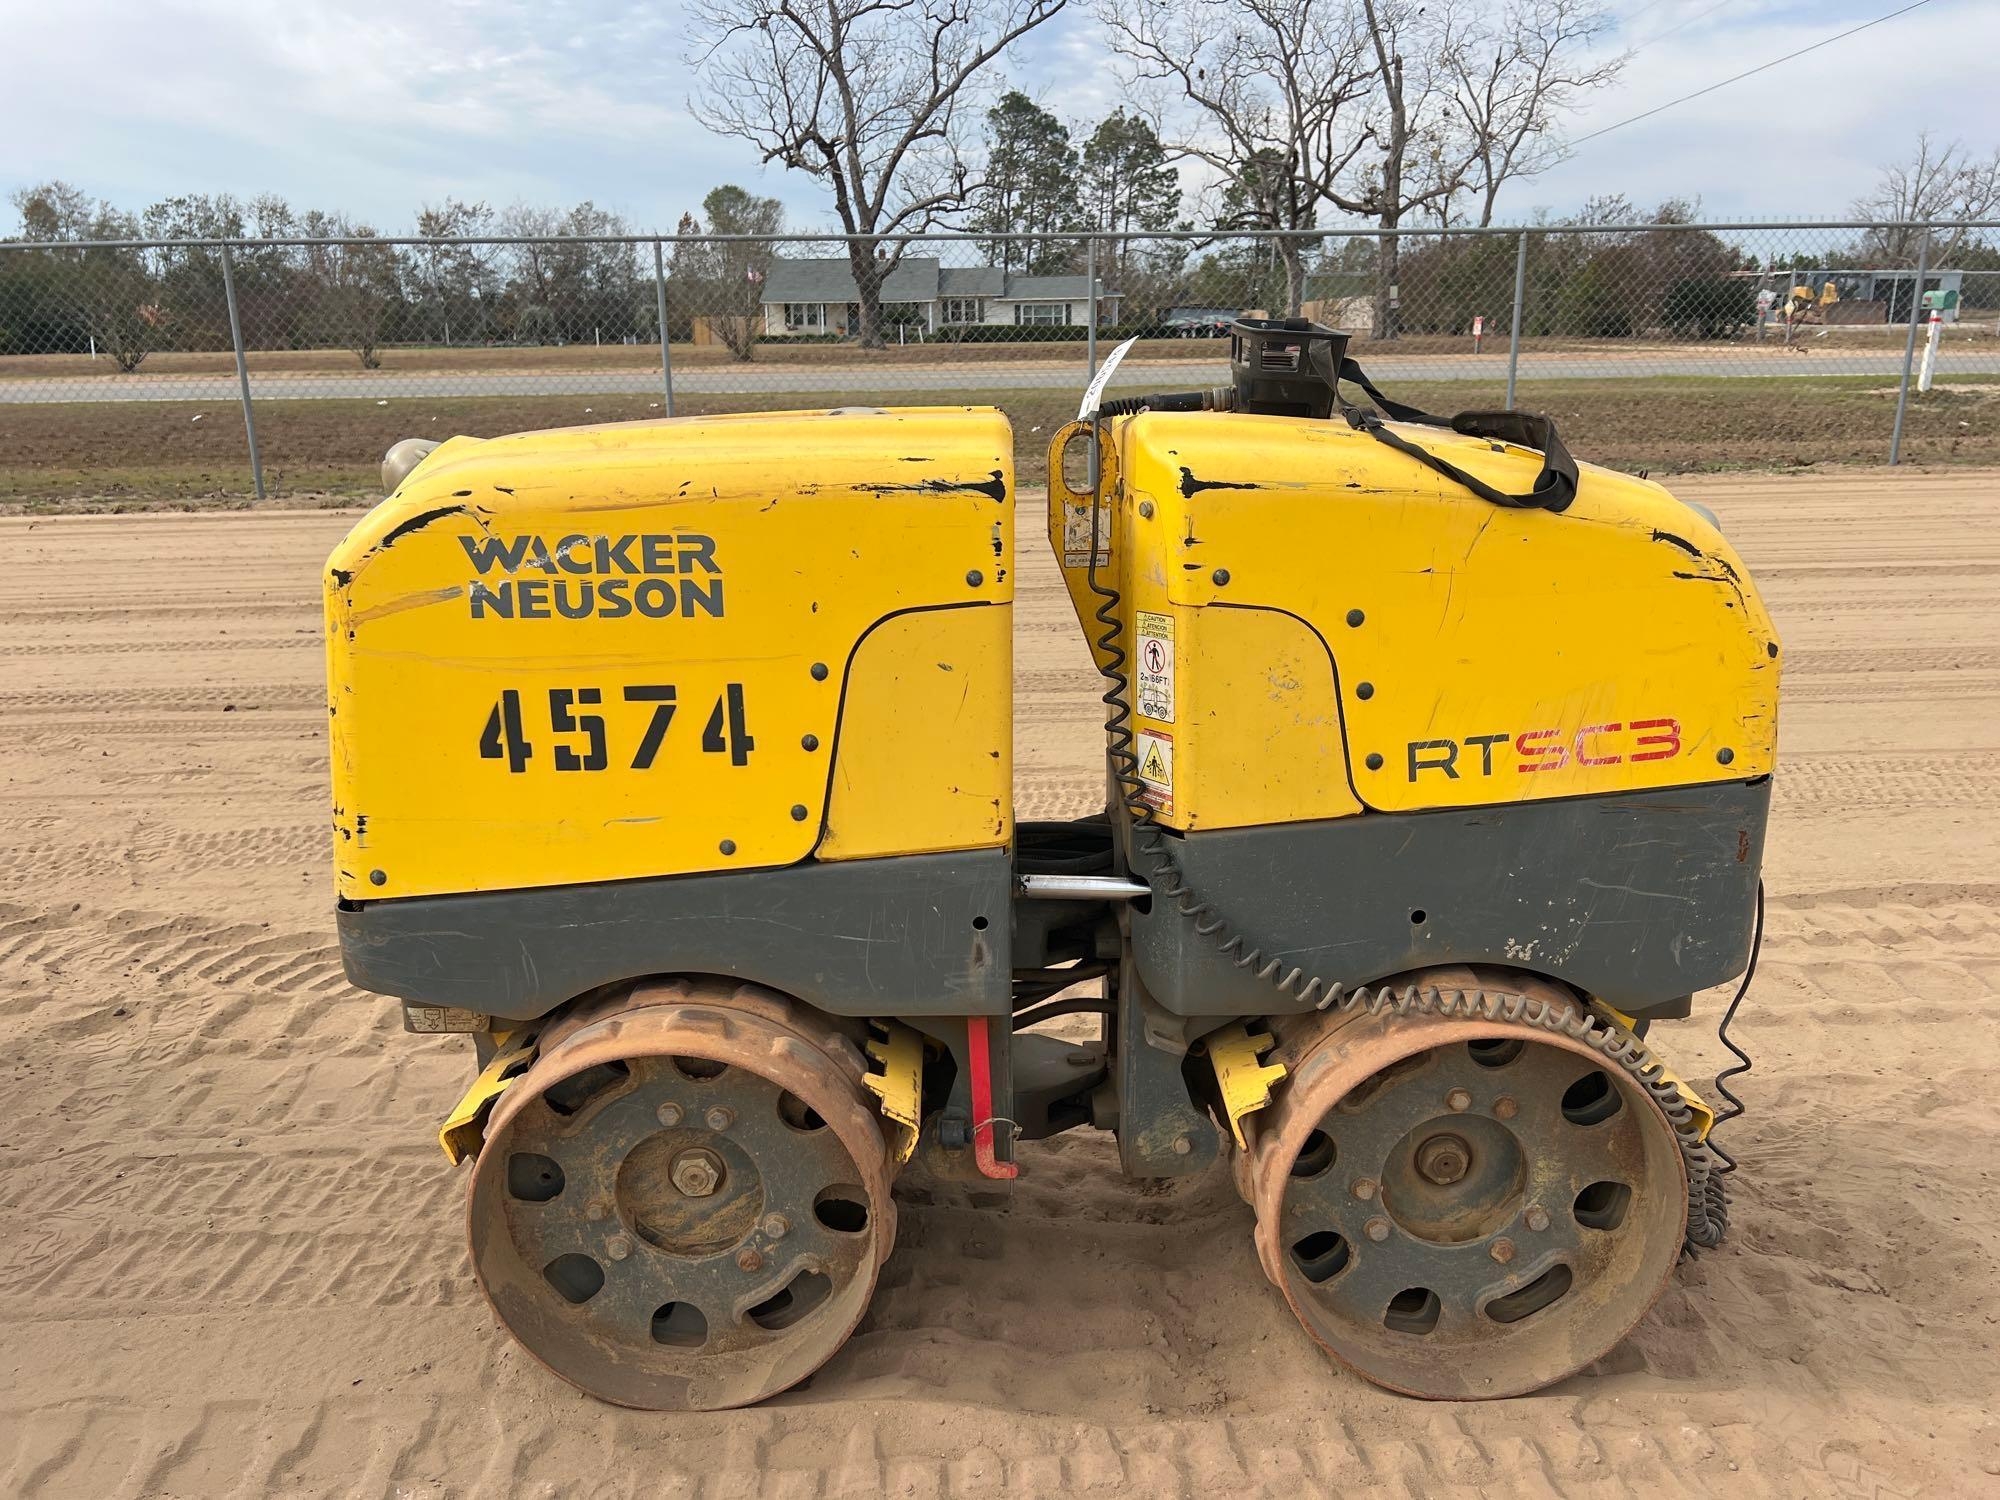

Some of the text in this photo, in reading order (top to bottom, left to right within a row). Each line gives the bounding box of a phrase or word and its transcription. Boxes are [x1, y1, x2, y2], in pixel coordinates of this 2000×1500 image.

[457, 534, 722, 575] WACKER
[469, 578, 725, 620] NEUSON
[1147, 615, 1166, 623] CAUTION
[479, 682, 755, 773] 4574
